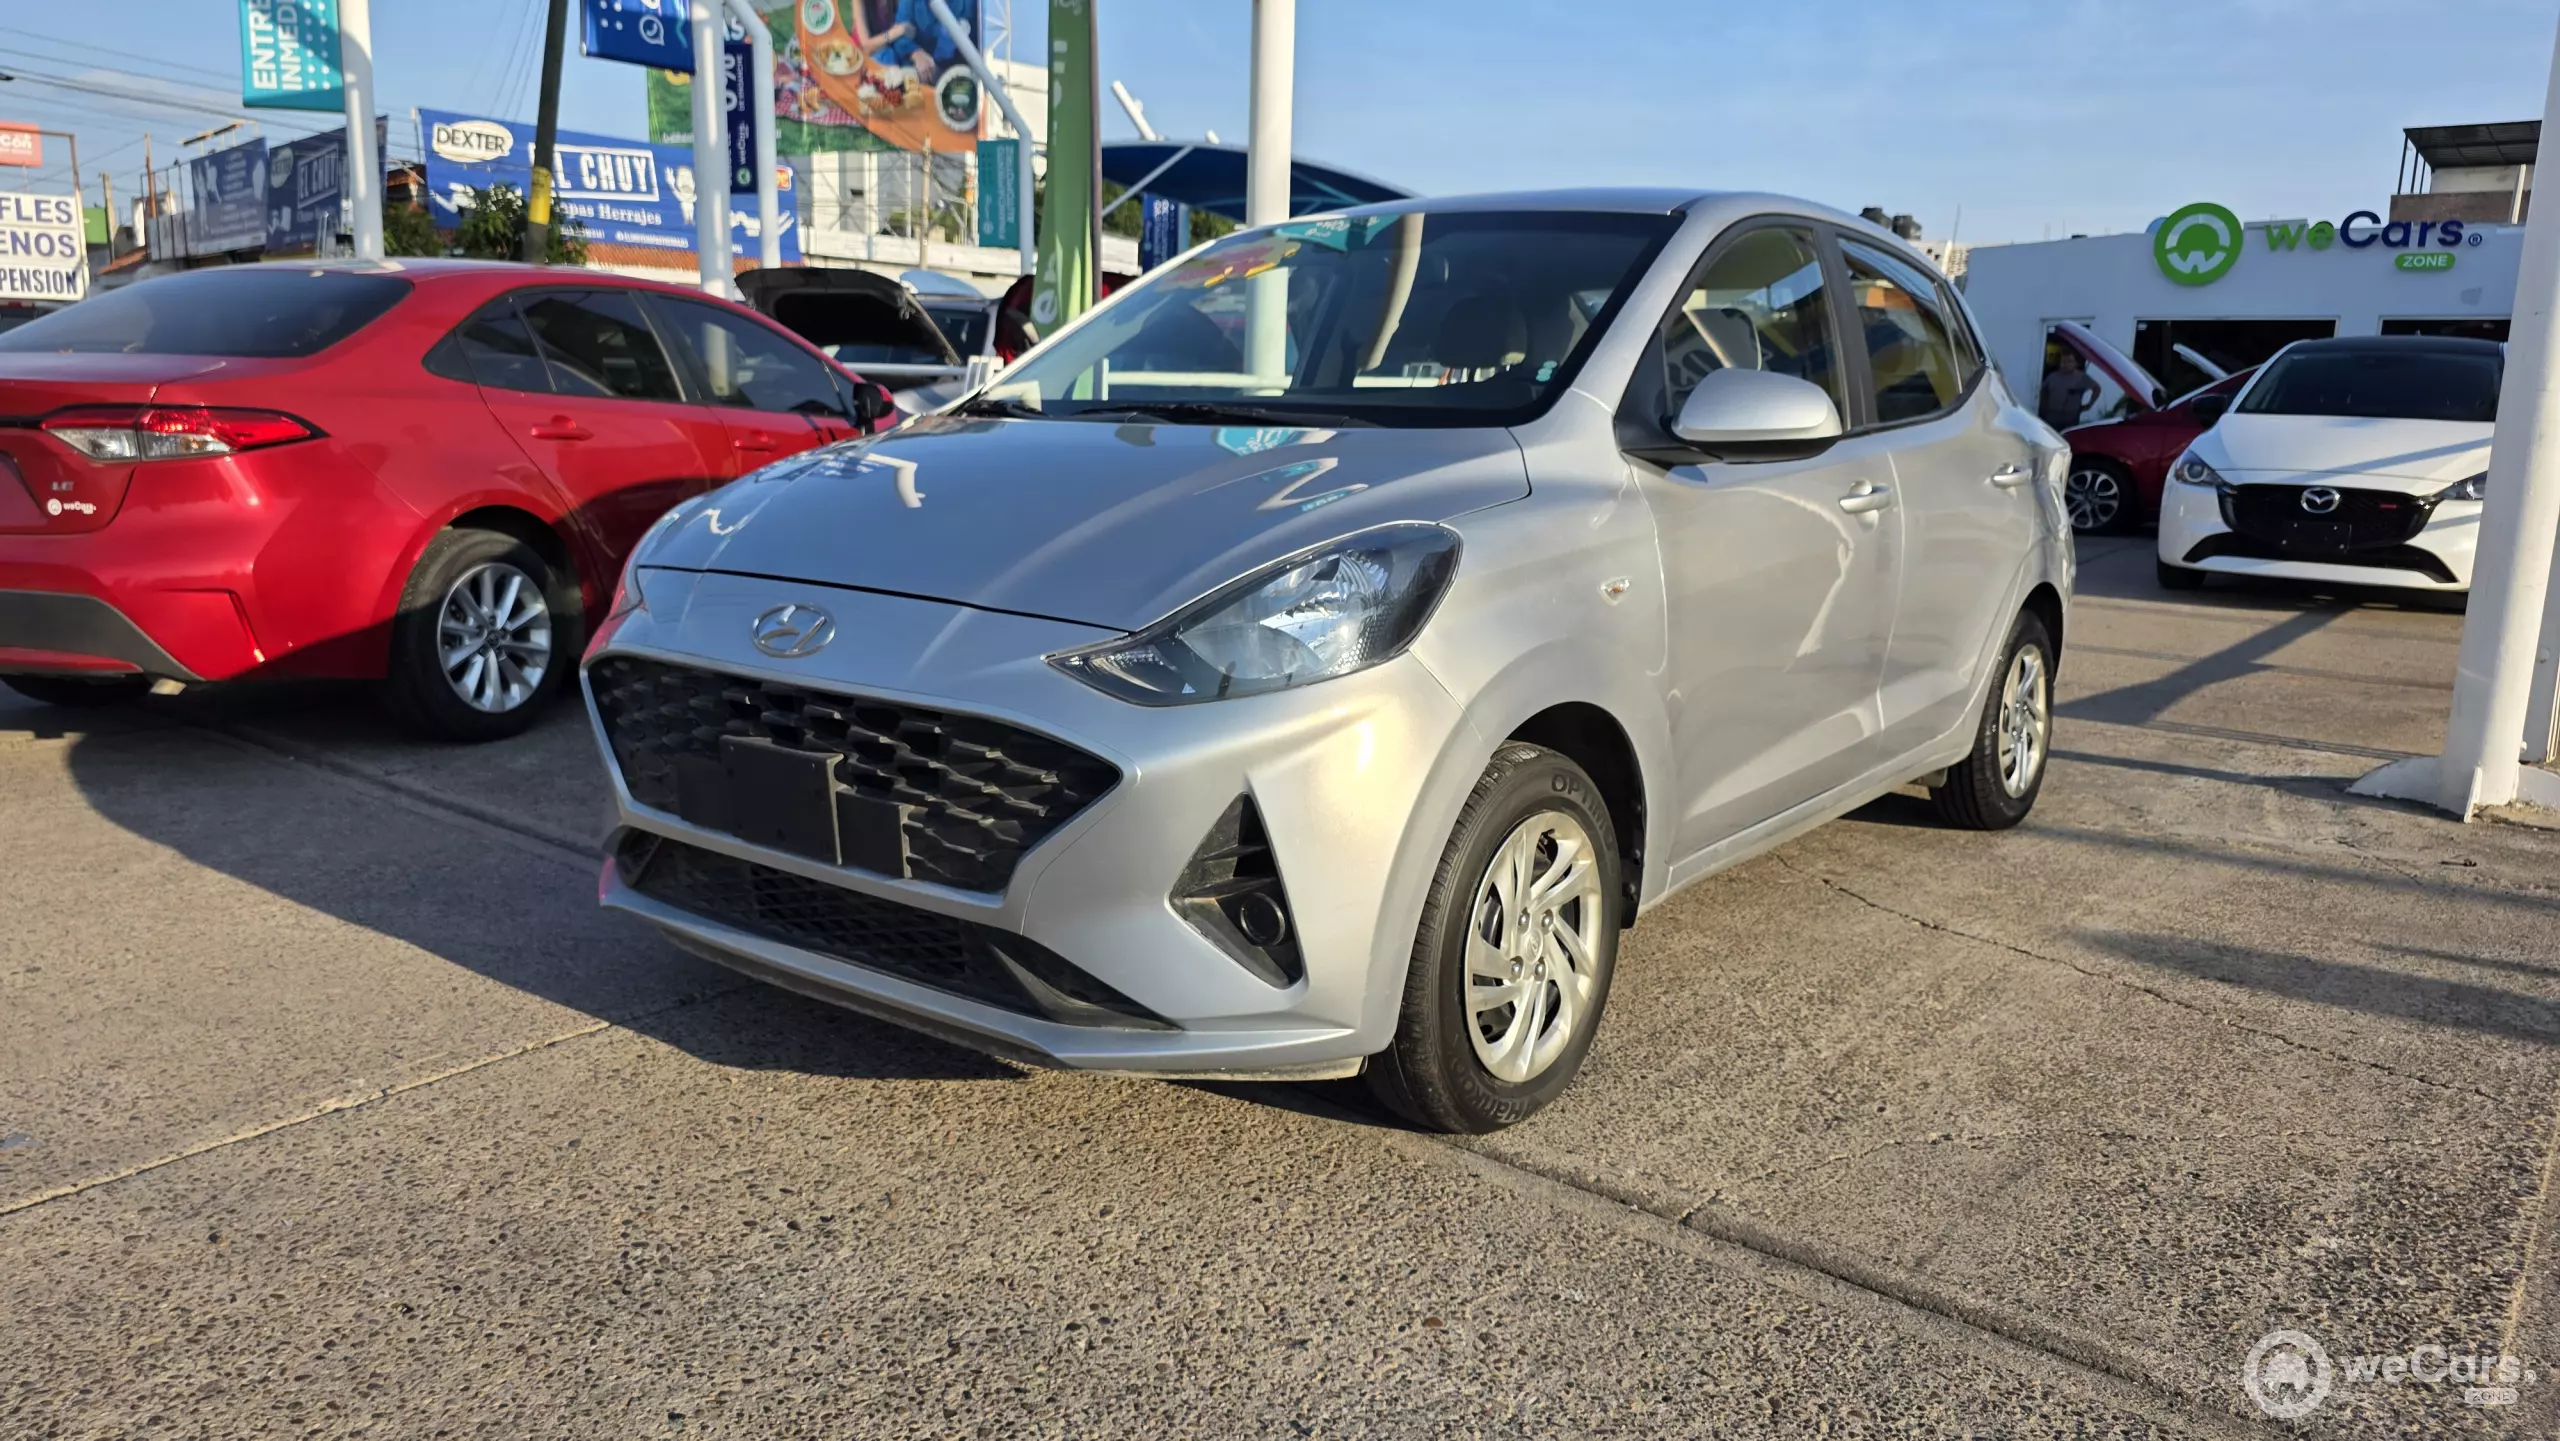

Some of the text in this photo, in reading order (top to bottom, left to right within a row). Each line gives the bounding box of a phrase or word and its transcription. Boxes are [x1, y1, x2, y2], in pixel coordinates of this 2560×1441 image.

[436, 126, 506, 153] DEXTER
[580, 152, 648, 192] CHUY
[597, 202, 662, 226] Herrajes
[2402, 254, 2448, 268] ZONE
[0, 266, 78, 295] PENSION
